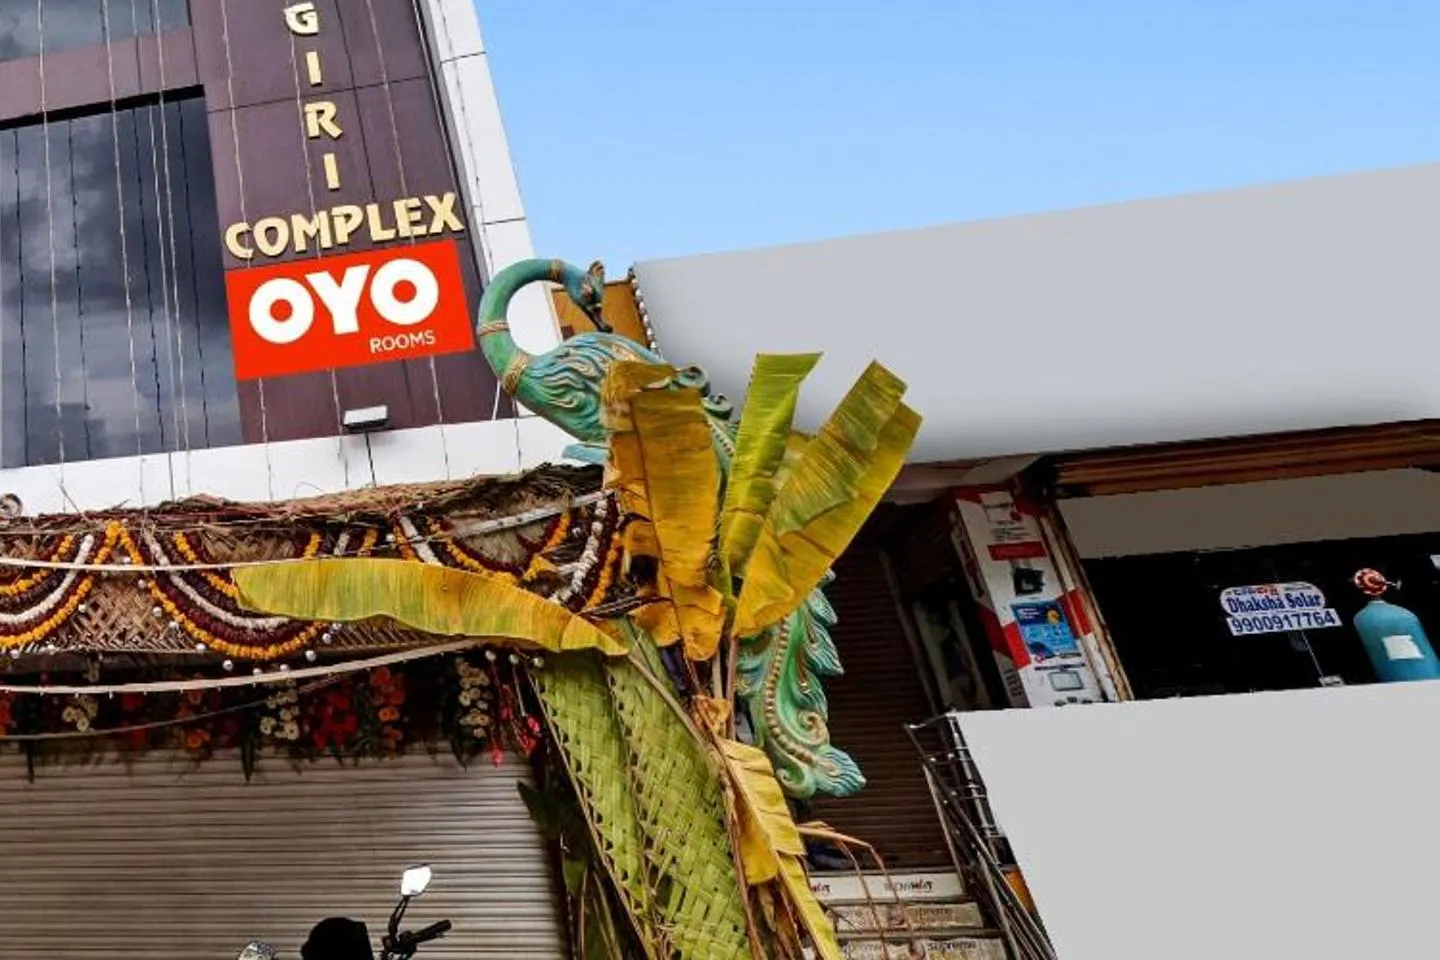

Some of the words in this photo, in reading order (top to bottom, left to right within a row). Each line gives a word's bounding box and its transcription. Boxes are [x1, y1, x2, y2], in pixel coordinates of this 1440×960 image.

[225, 192, 464, 259] COMPLEX
[249, 259, 439, 344] OYO
[369, 330, 436, 353] ROOMS
[1226, 594, 1285, 613] Dhaksha
[1285, 592, 1321, 609] Solar
[1232, 611, 1336, 632] 9900917764
